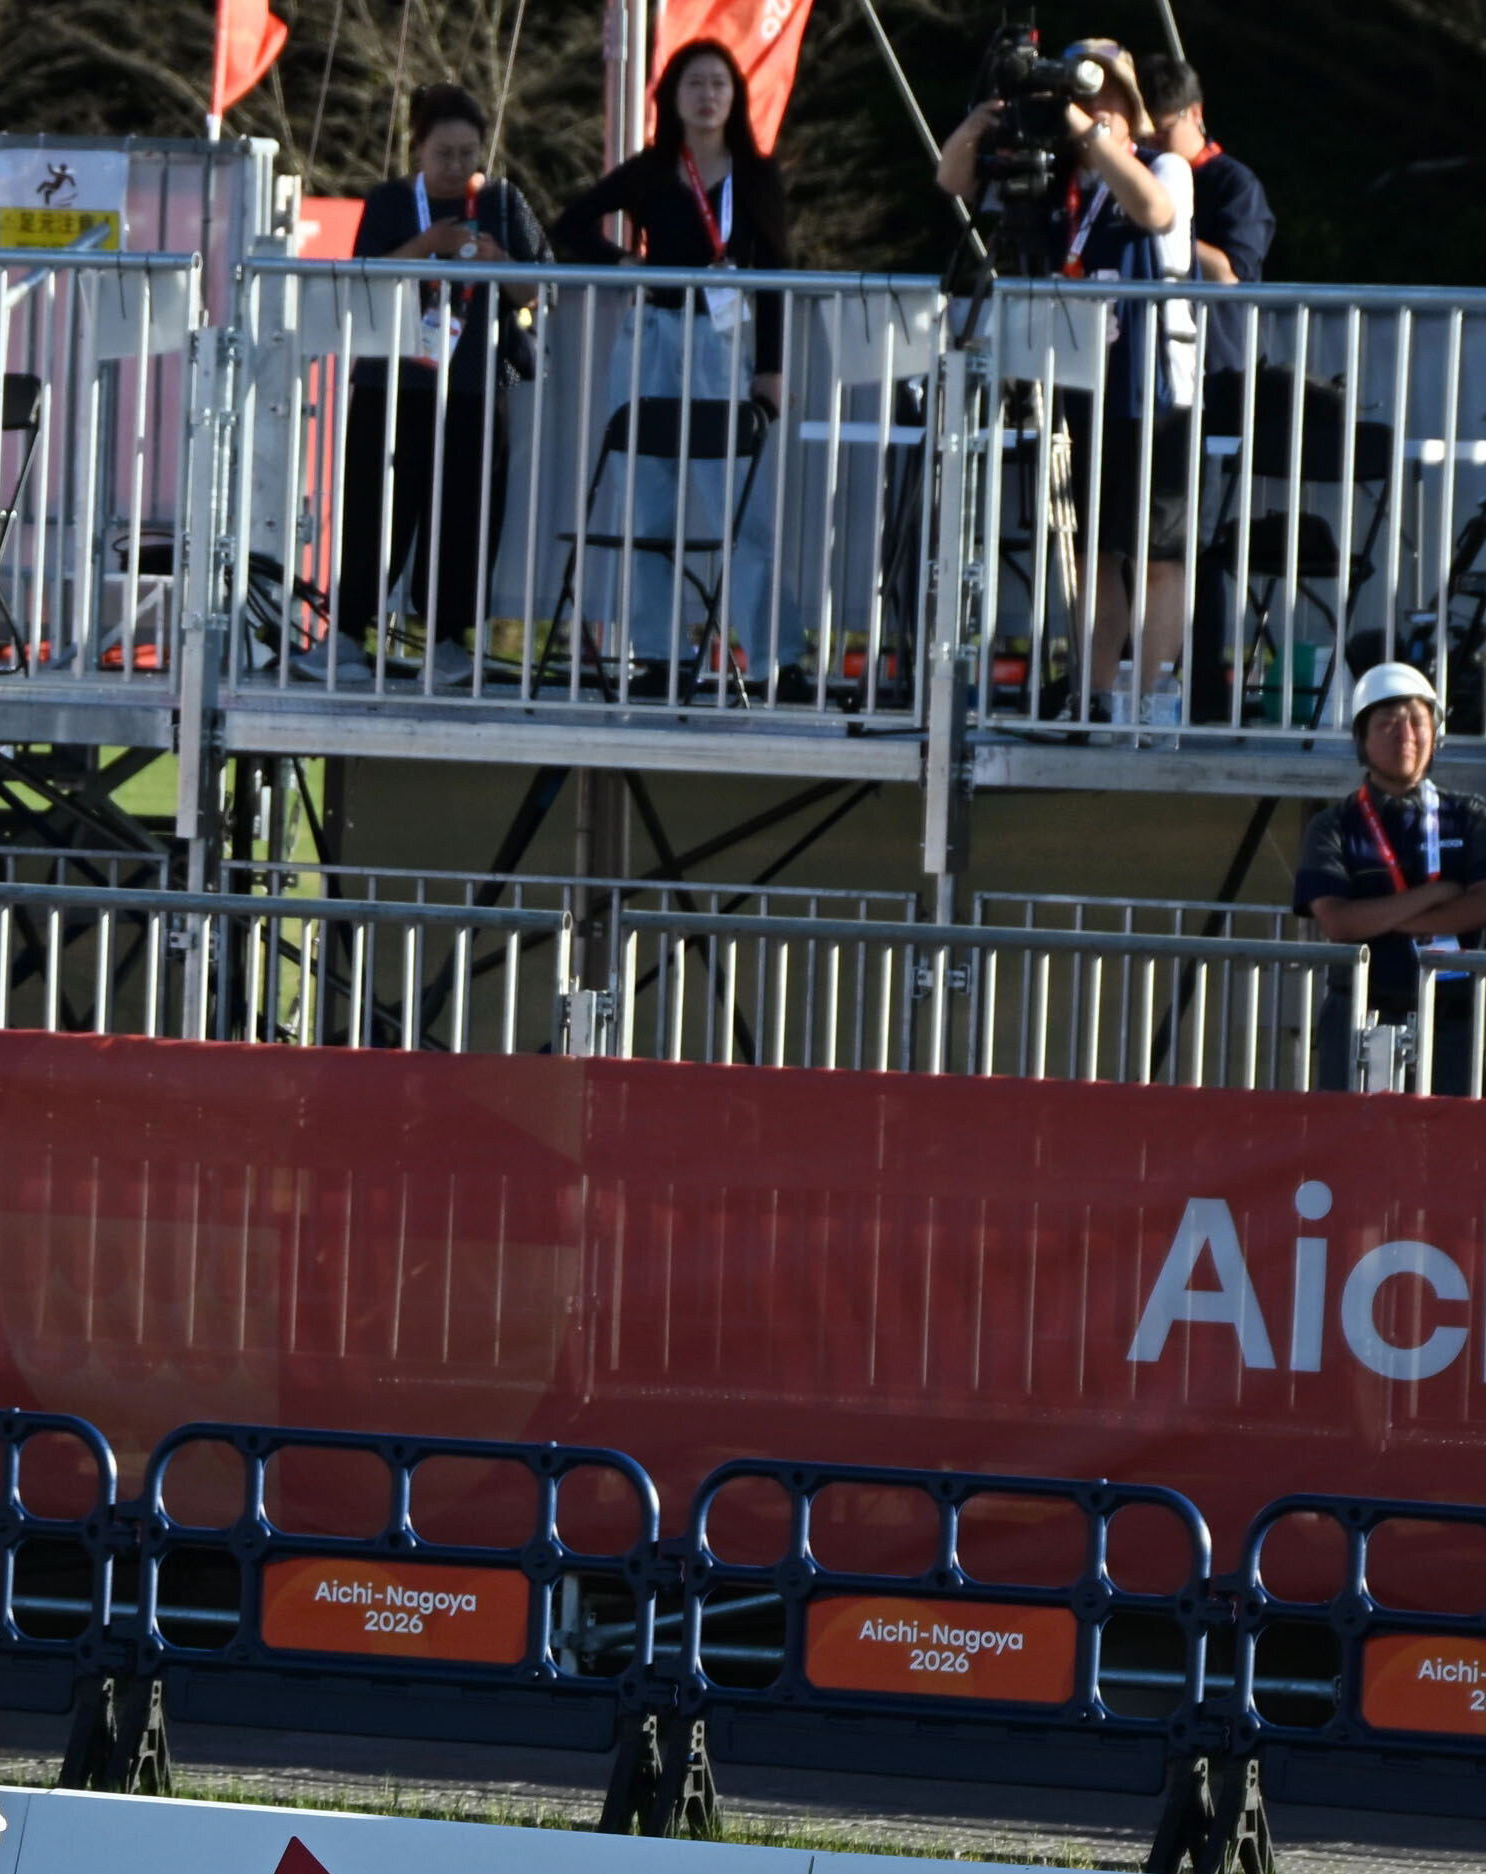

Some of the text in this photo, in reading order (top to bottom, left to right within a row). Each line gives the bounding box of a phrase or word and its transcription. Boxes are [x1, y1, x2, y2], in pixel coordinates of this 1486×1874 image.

[314, 1579, 477, 1617] Aichi-Nagoya
[364, 1610, 425, 1636] 2026
[859, 1617, 1024, 1657] Aichi-Nagoya
[909, 1649, 970, 1675] 2026
